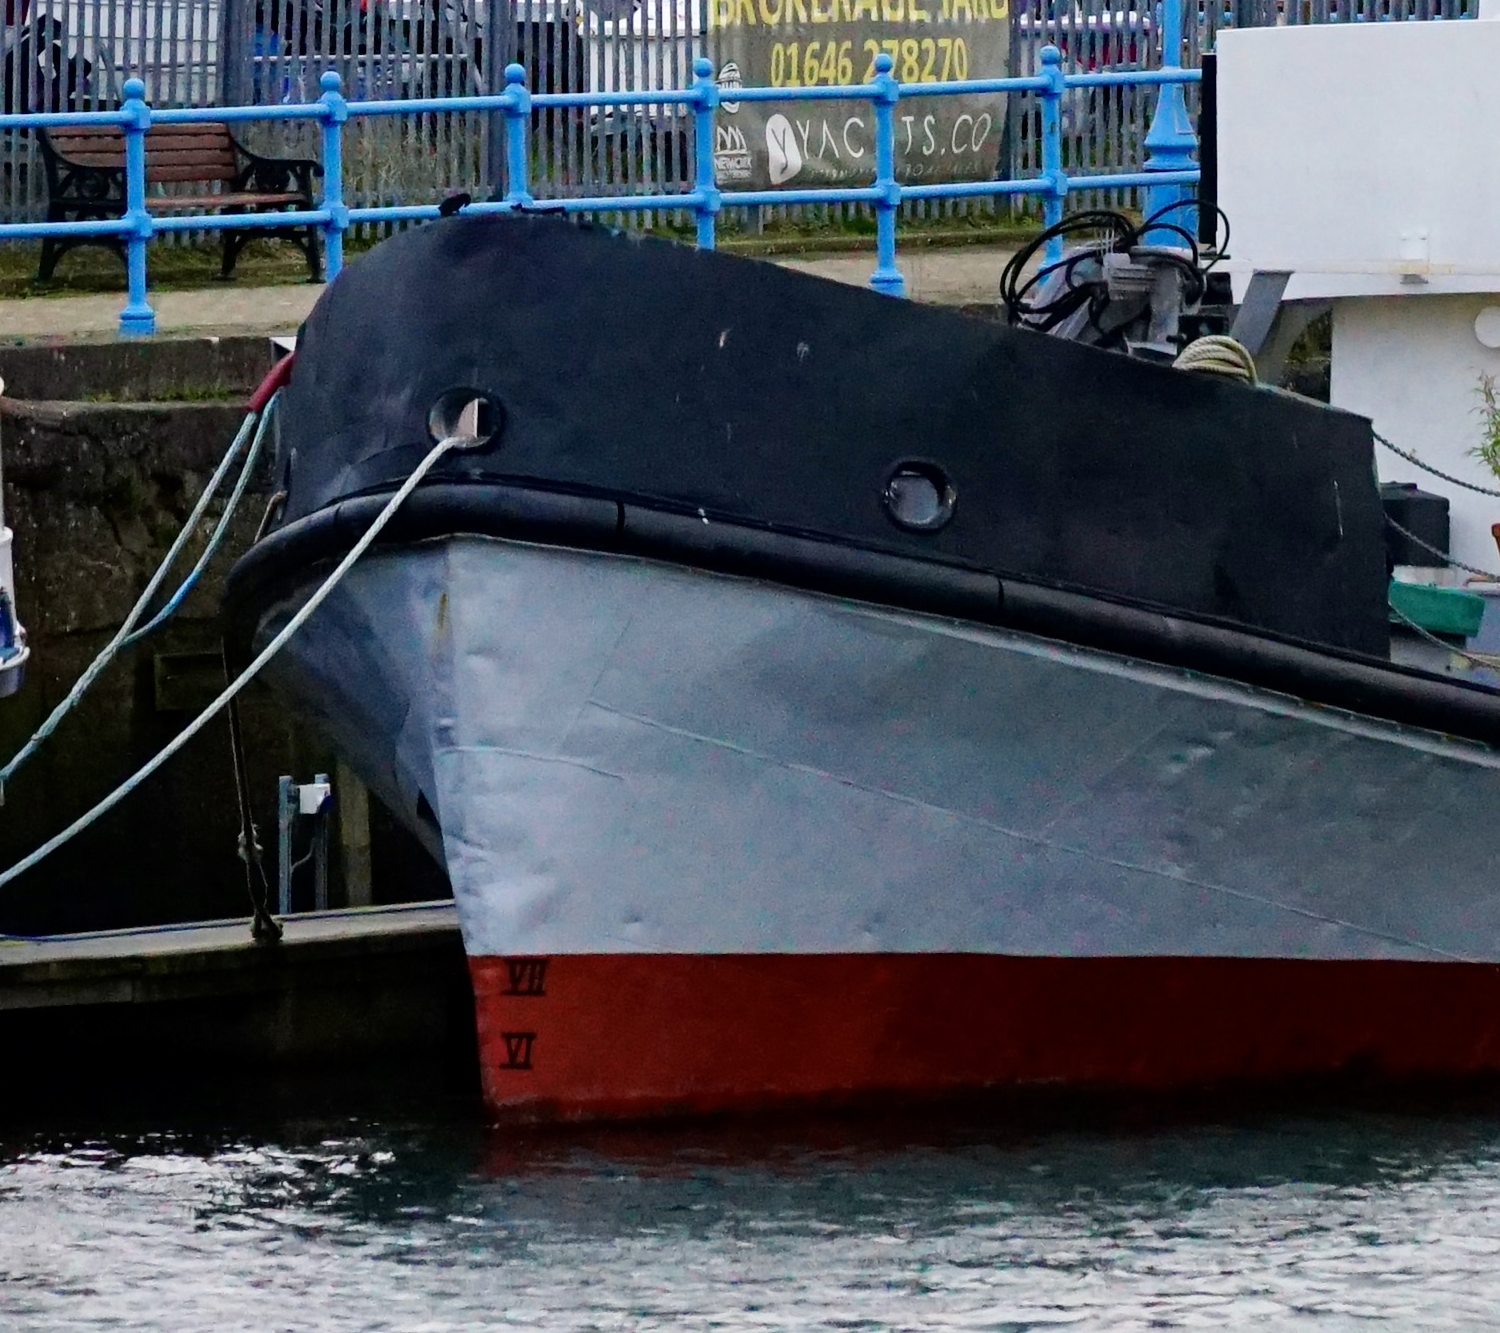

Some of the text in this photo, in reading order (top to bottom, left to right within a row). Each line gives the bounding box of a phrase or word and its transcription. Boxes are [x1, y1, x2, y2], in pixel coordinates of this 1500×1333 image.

[770, 37, 969, 87] 01646 278270
[795, 113, 992, 160] YACTS.CO
[499, 1032, 537, 1070] VI
